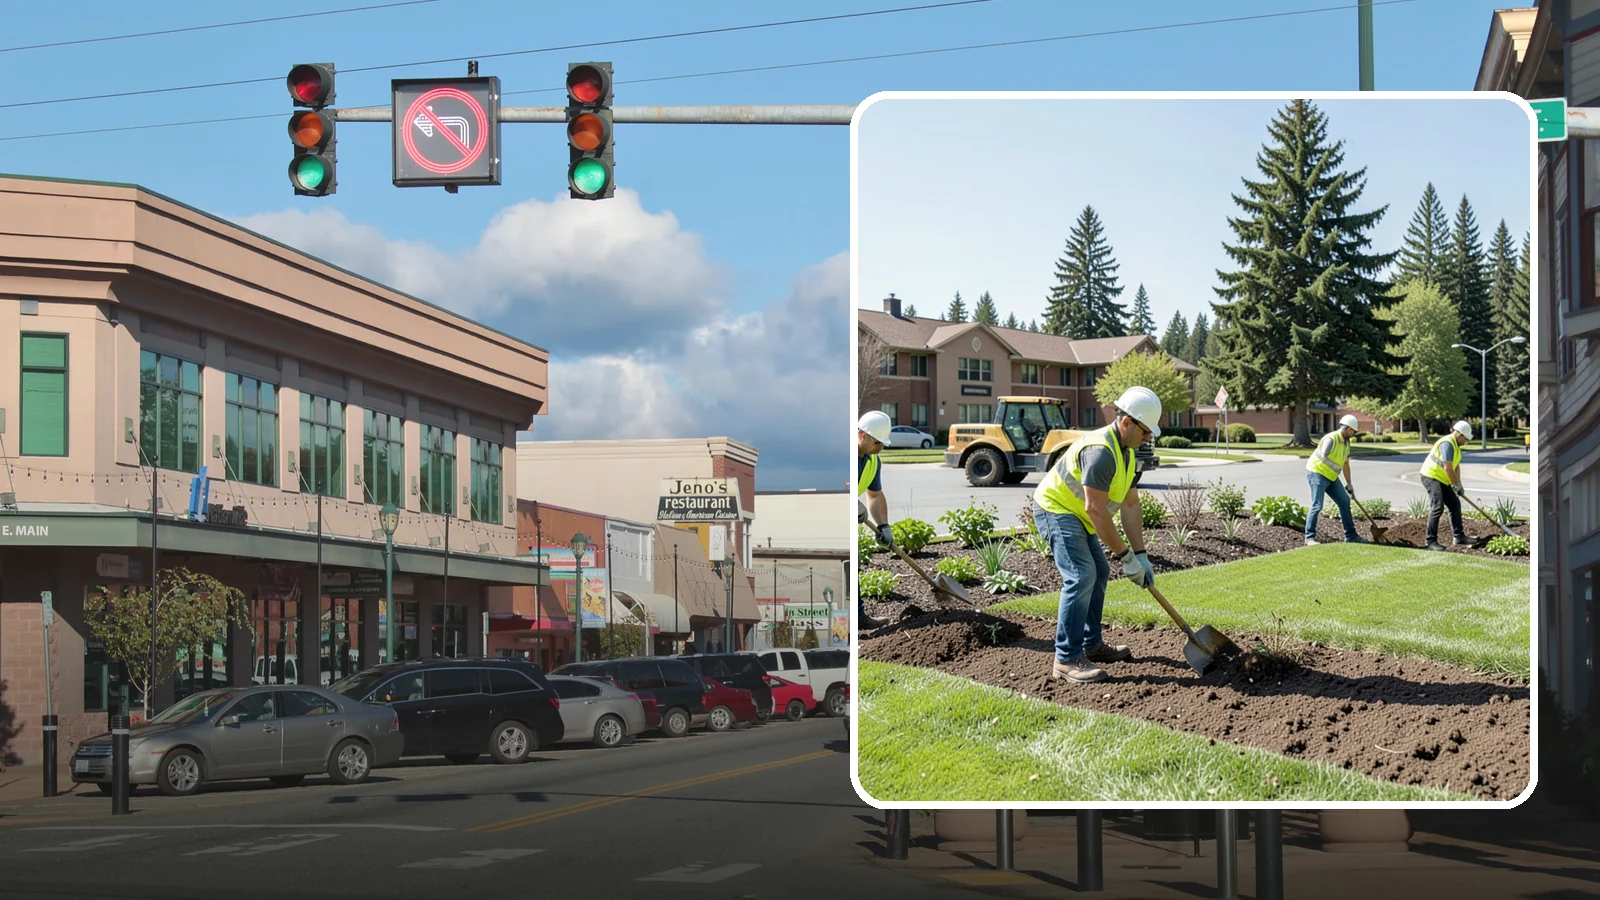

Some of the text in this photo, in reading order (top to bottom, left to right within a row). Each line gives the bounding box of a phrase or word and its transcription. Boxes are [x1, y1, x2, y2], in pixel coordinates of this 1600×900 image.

[669, 480, 727, 495] Jeno's
[665, 496, 731, 509] restaurant
[658, 510, 682, 520] Italian
[686, 510, 715, 520] American
[715, 509, 738, 520] Cuisine
[2, 525, 49, 536] E. MAIN
[797, 607, 828, 617] Street
